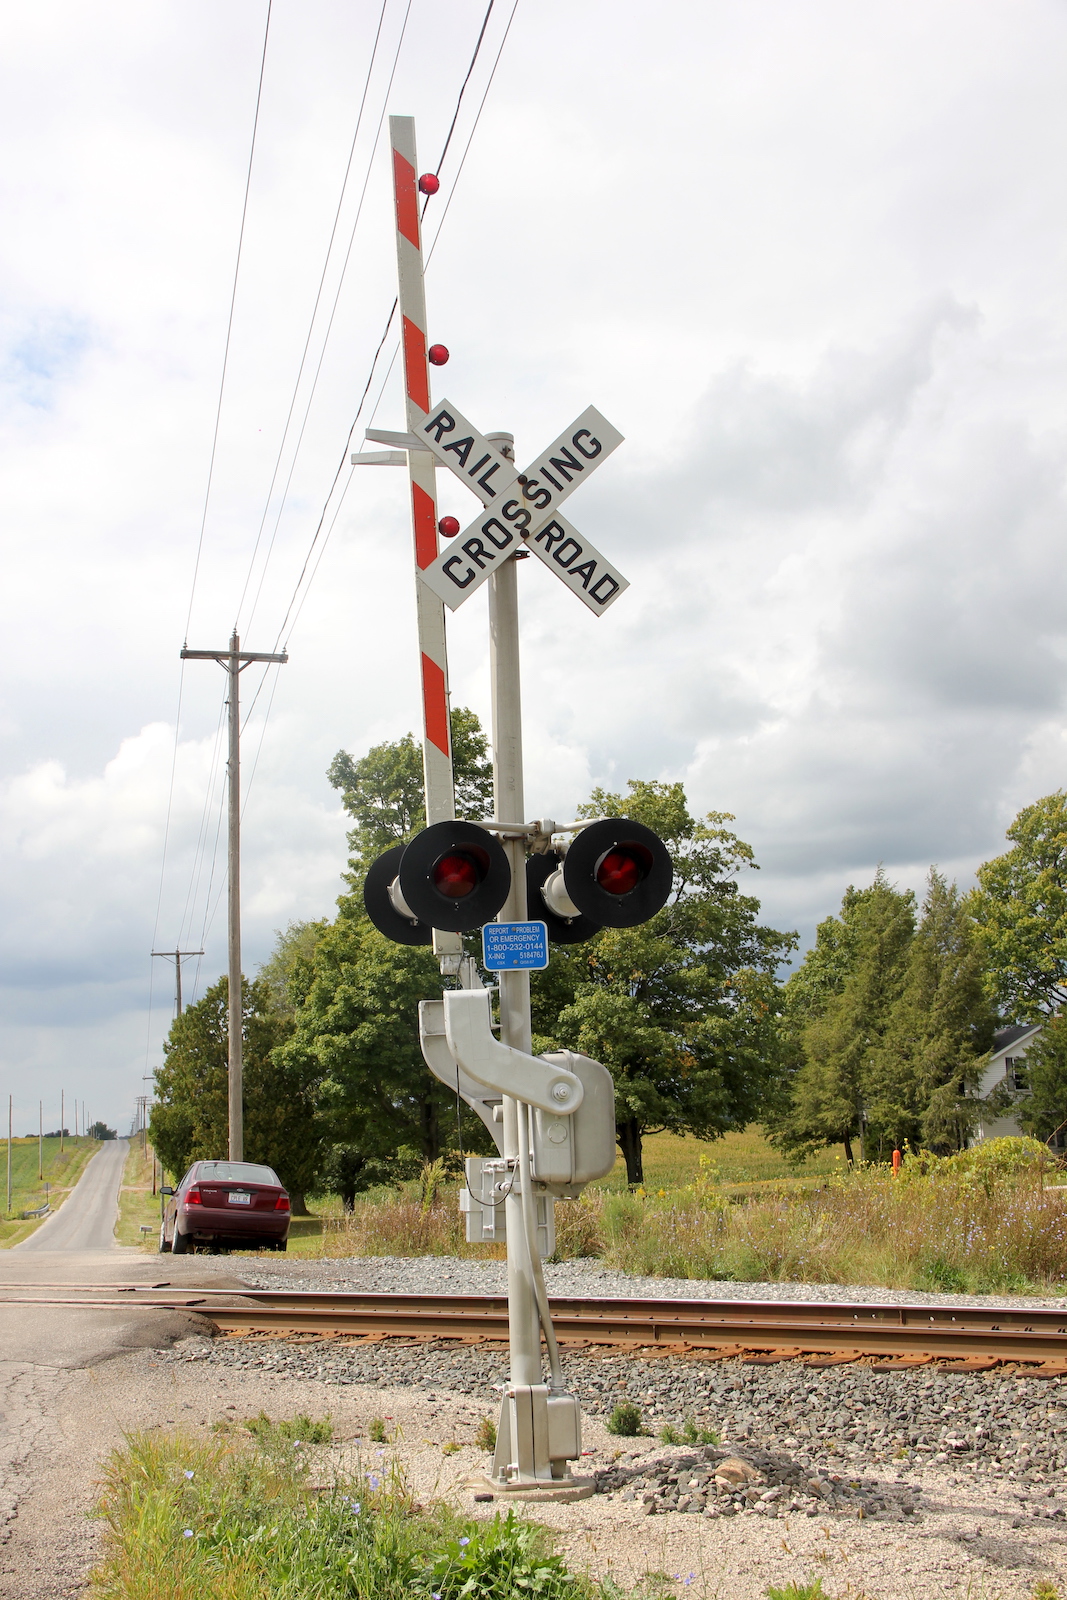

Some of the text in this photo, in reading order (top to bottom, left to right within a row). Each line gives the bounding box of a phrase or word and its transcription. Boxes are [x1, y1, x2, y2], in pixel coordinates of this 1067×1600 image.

[424, 409, 501, 498] RAIL
[442, 428, 602, 589] CROSSING
[534, 519, 620, 606] ROAD
[487, 943, 543, 952] 1-800-232-0144
[500, 934, 540, 942] EMERGENCY
